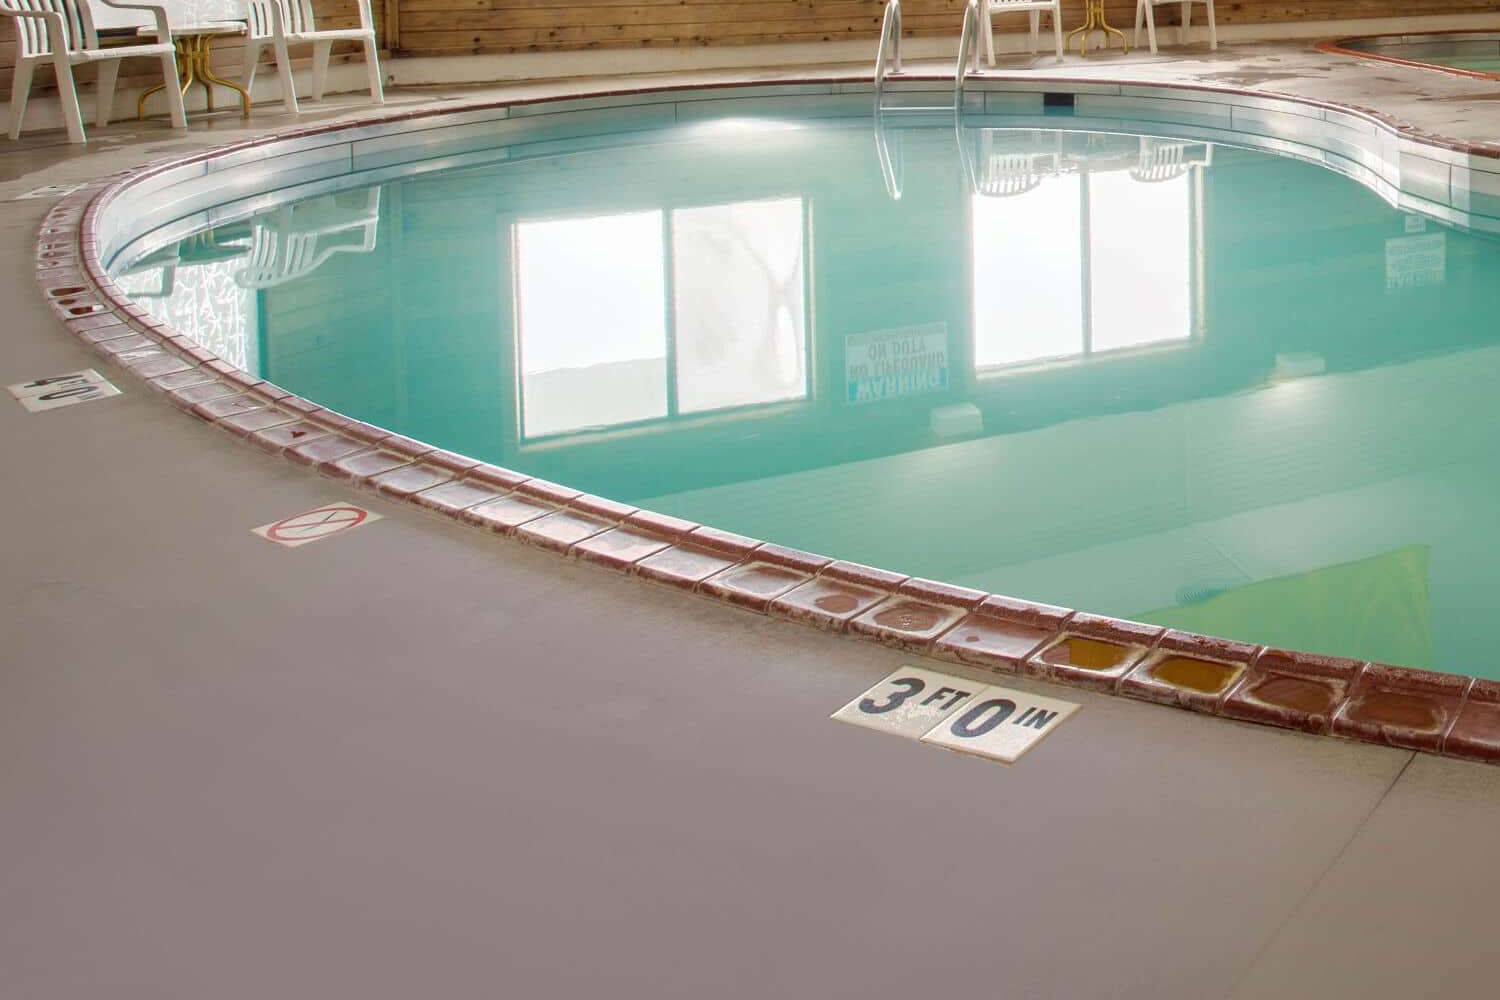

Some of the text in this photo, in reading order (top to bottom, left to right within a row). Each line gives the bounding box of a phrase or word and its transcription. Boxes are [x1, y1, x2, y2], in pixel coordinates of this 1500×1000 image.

[859, 677, 1058, 738] 3 FT 0 IN
